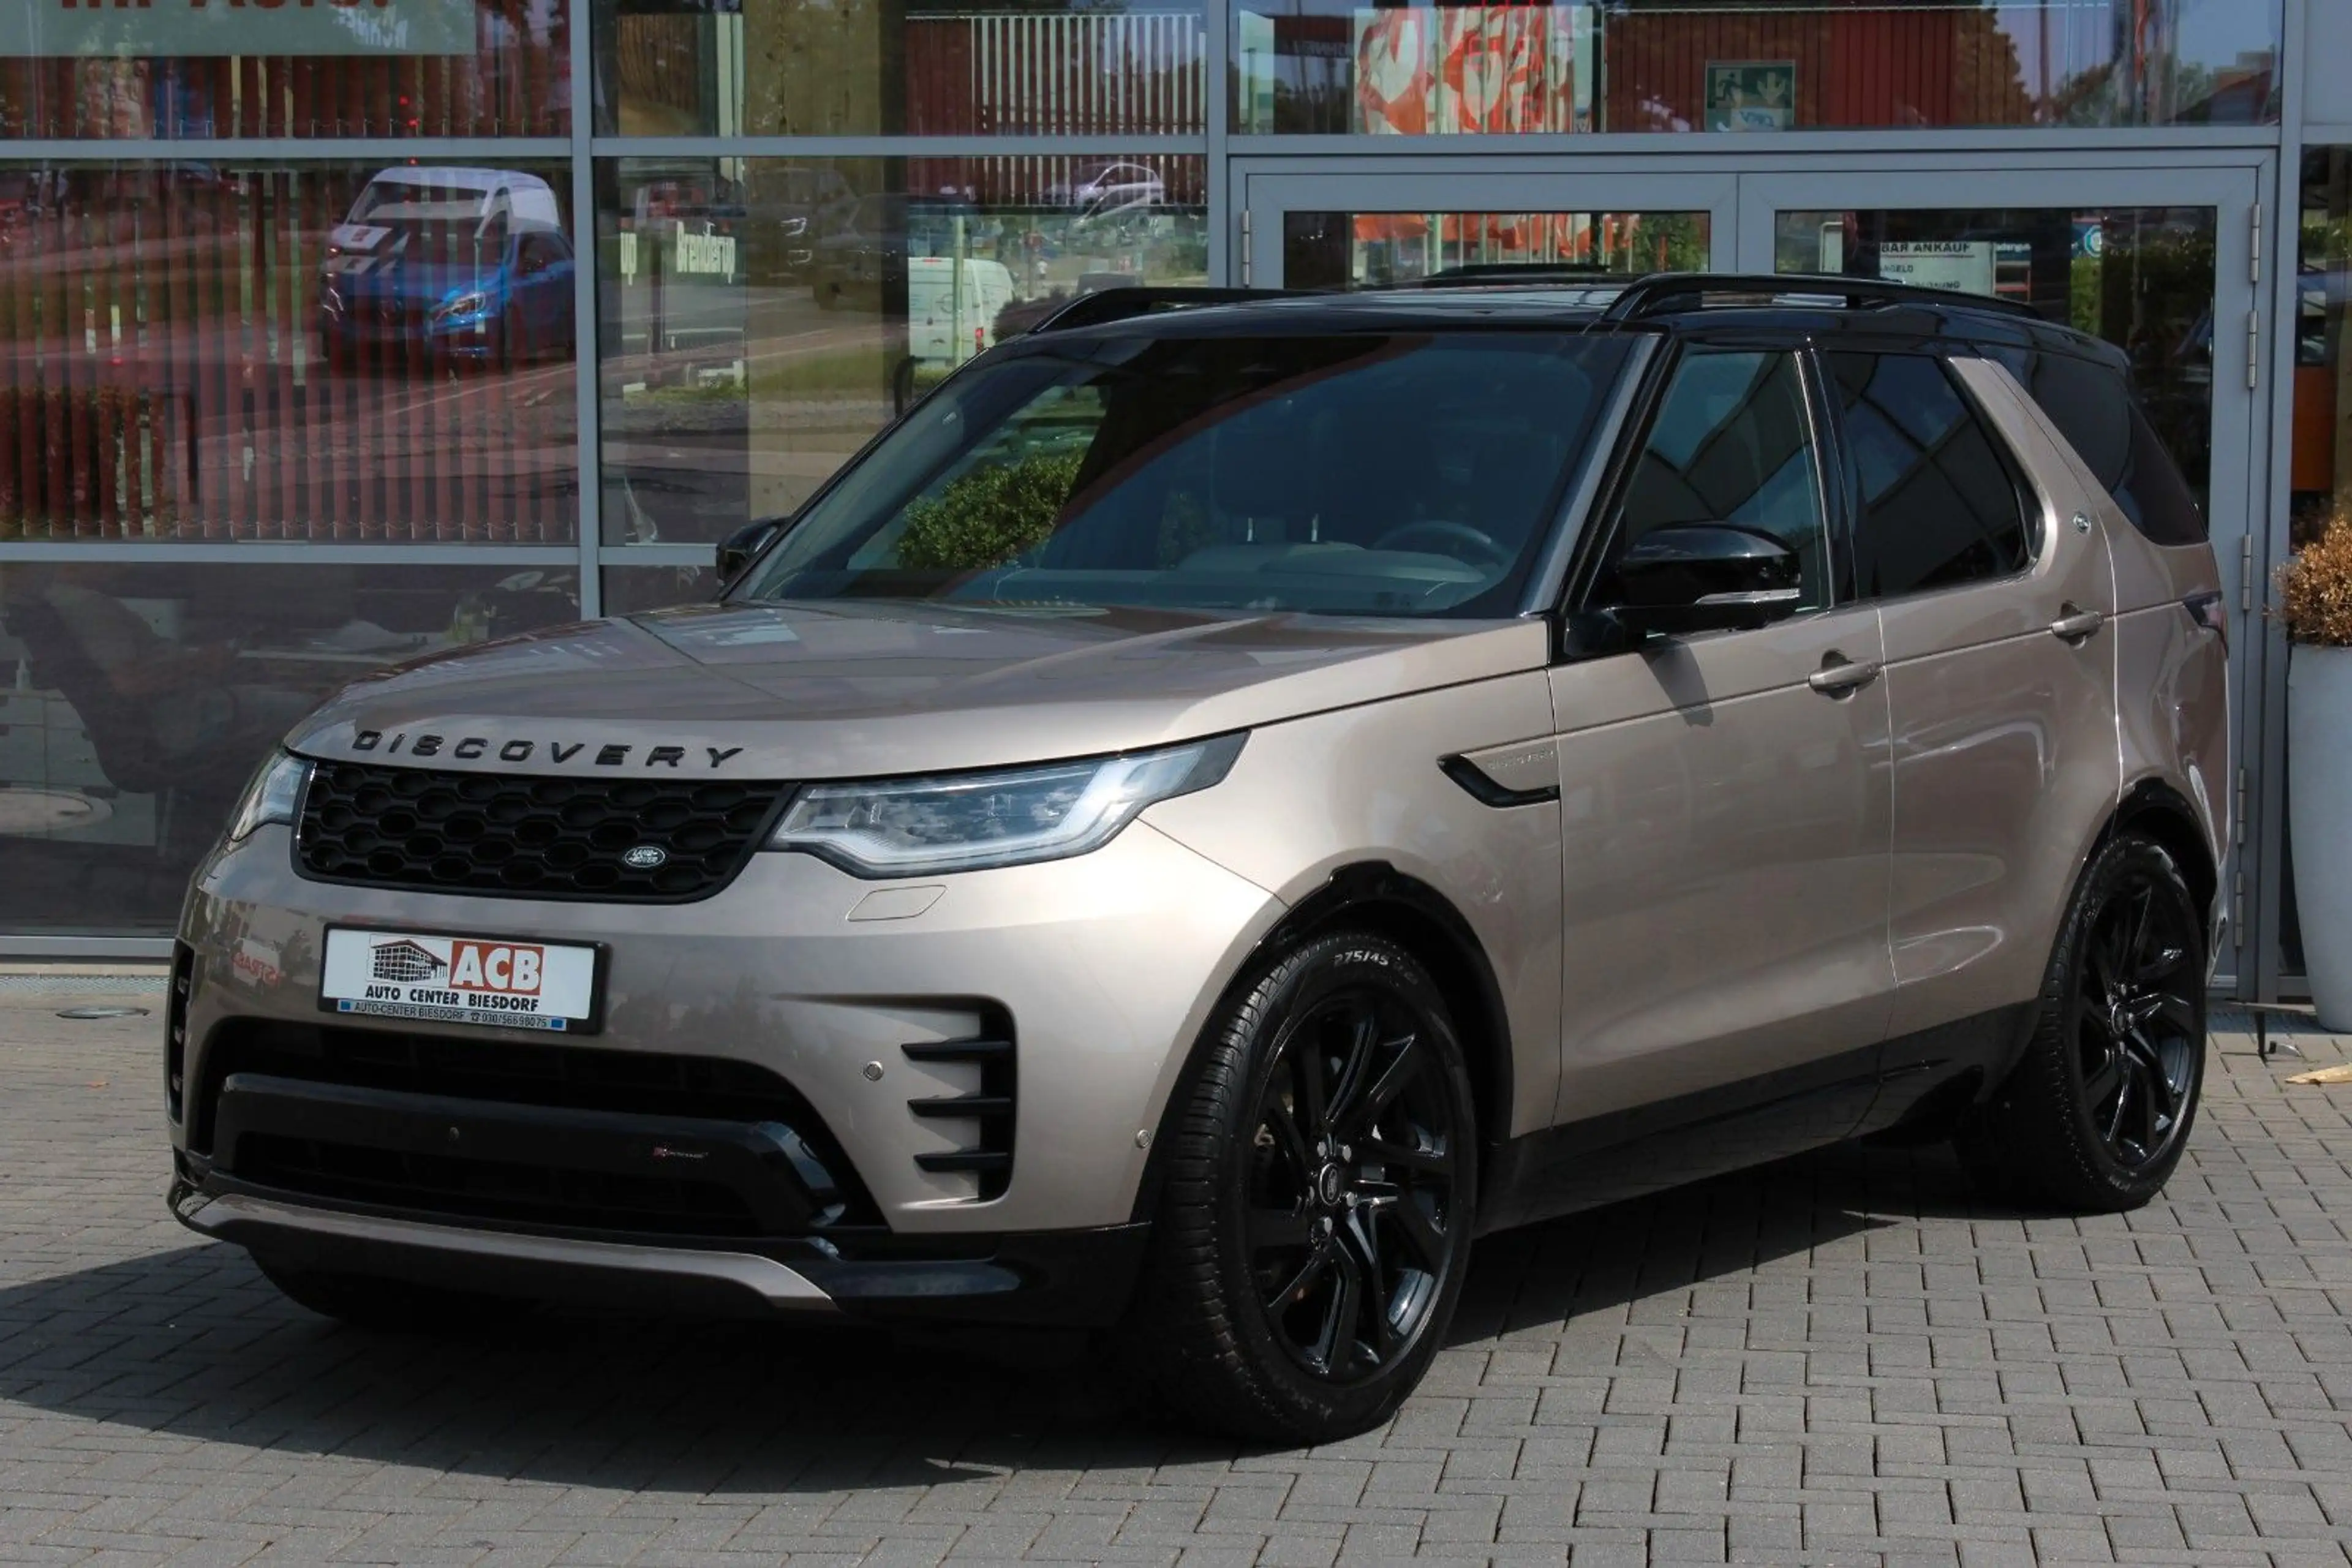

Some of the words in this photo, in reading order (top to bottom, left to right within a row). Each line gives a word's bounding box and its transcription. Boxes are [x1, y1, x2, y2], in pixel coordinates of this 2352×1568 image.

[352, 729, 743, 768] DISCOVERY
[451, 946, 540, 991] ACB
[365, 986, 401, 1001] AUTO
[409, 988, 459, 1006] CENTER
[468, 994, 540, 1012] BIESDORF
[418, 1005, 466, 1022] BIESDORF
